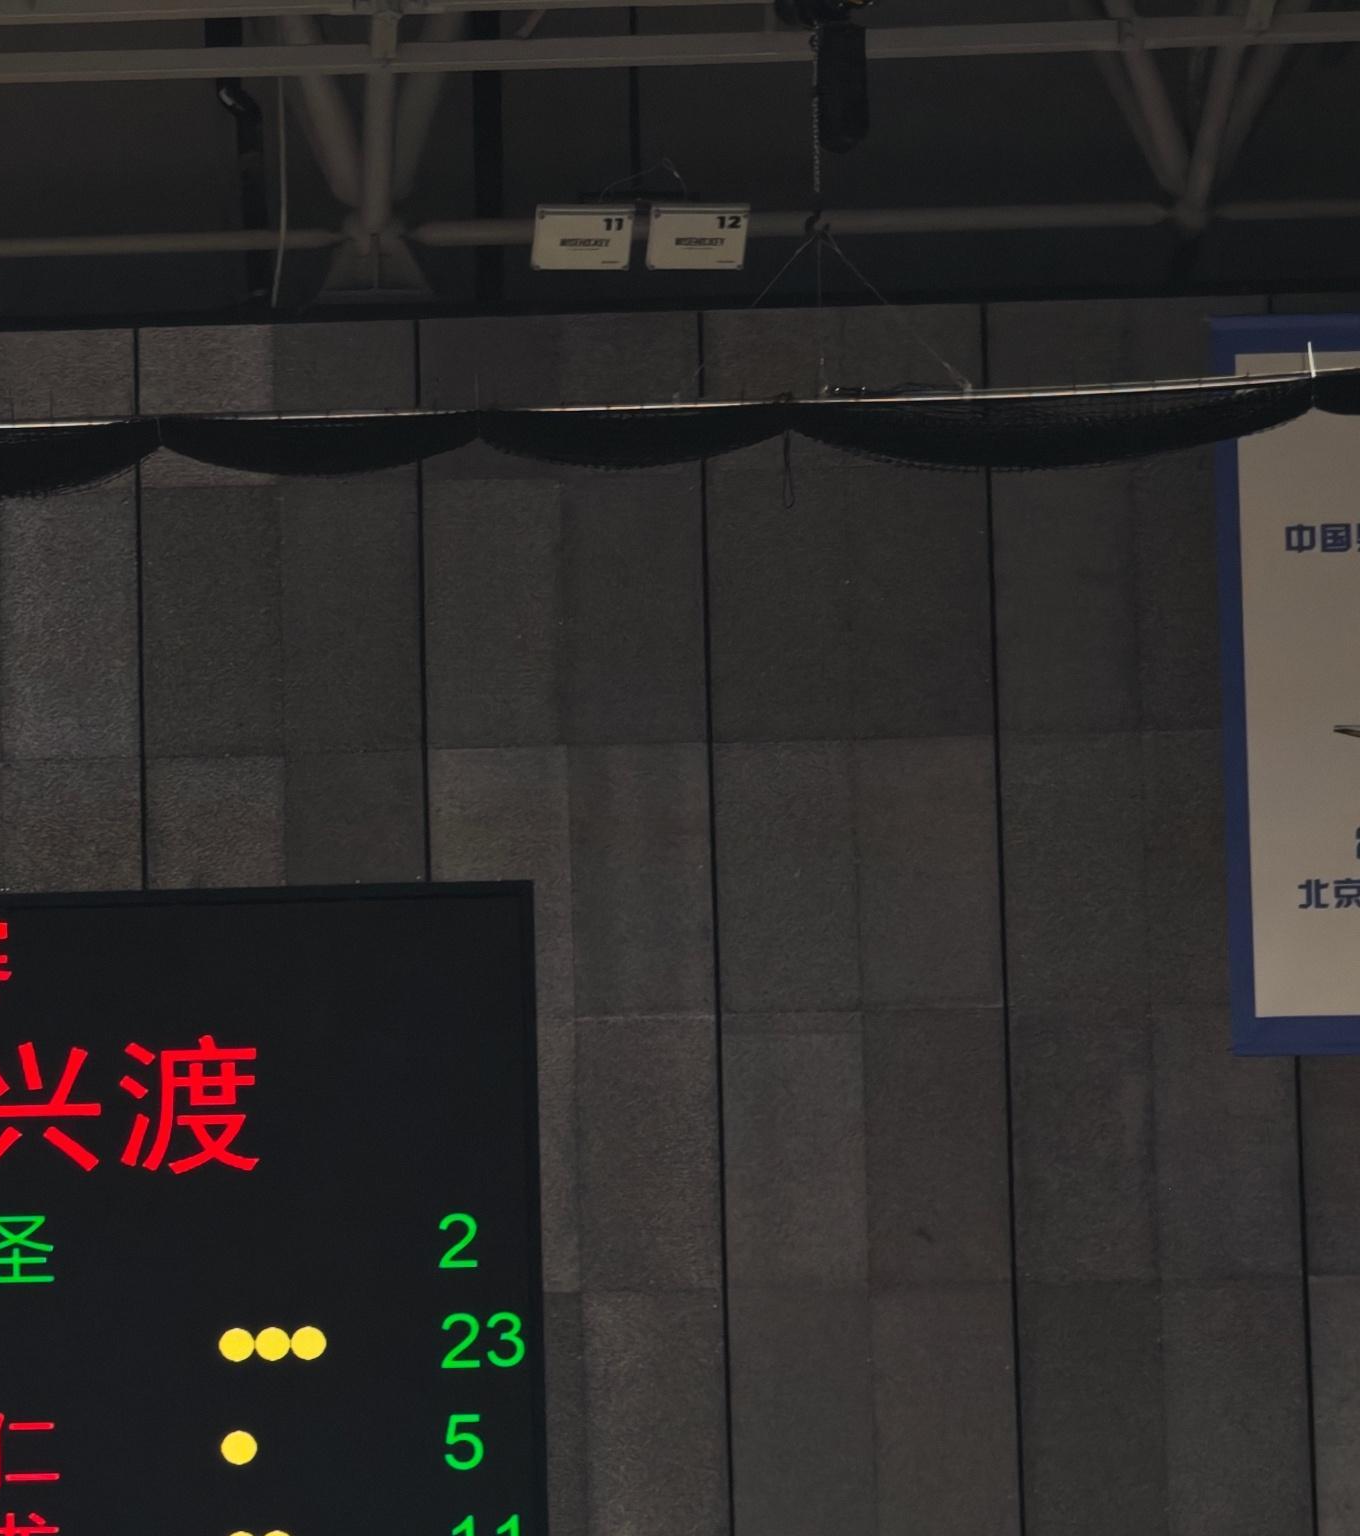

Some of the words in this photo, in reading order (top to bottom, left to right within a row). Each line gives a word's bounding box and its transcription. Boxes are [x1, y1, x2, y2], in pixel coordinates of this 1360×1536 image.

[603, 217, 624, 231] 11
[716, 215, 742, 229] 12
[1285, 523, 1360, 553] 中国
[438, 1213, 478, 1269] 2
[441, 1311, 526, 1369] 23
[444, 1413, 484, 1471] 5
